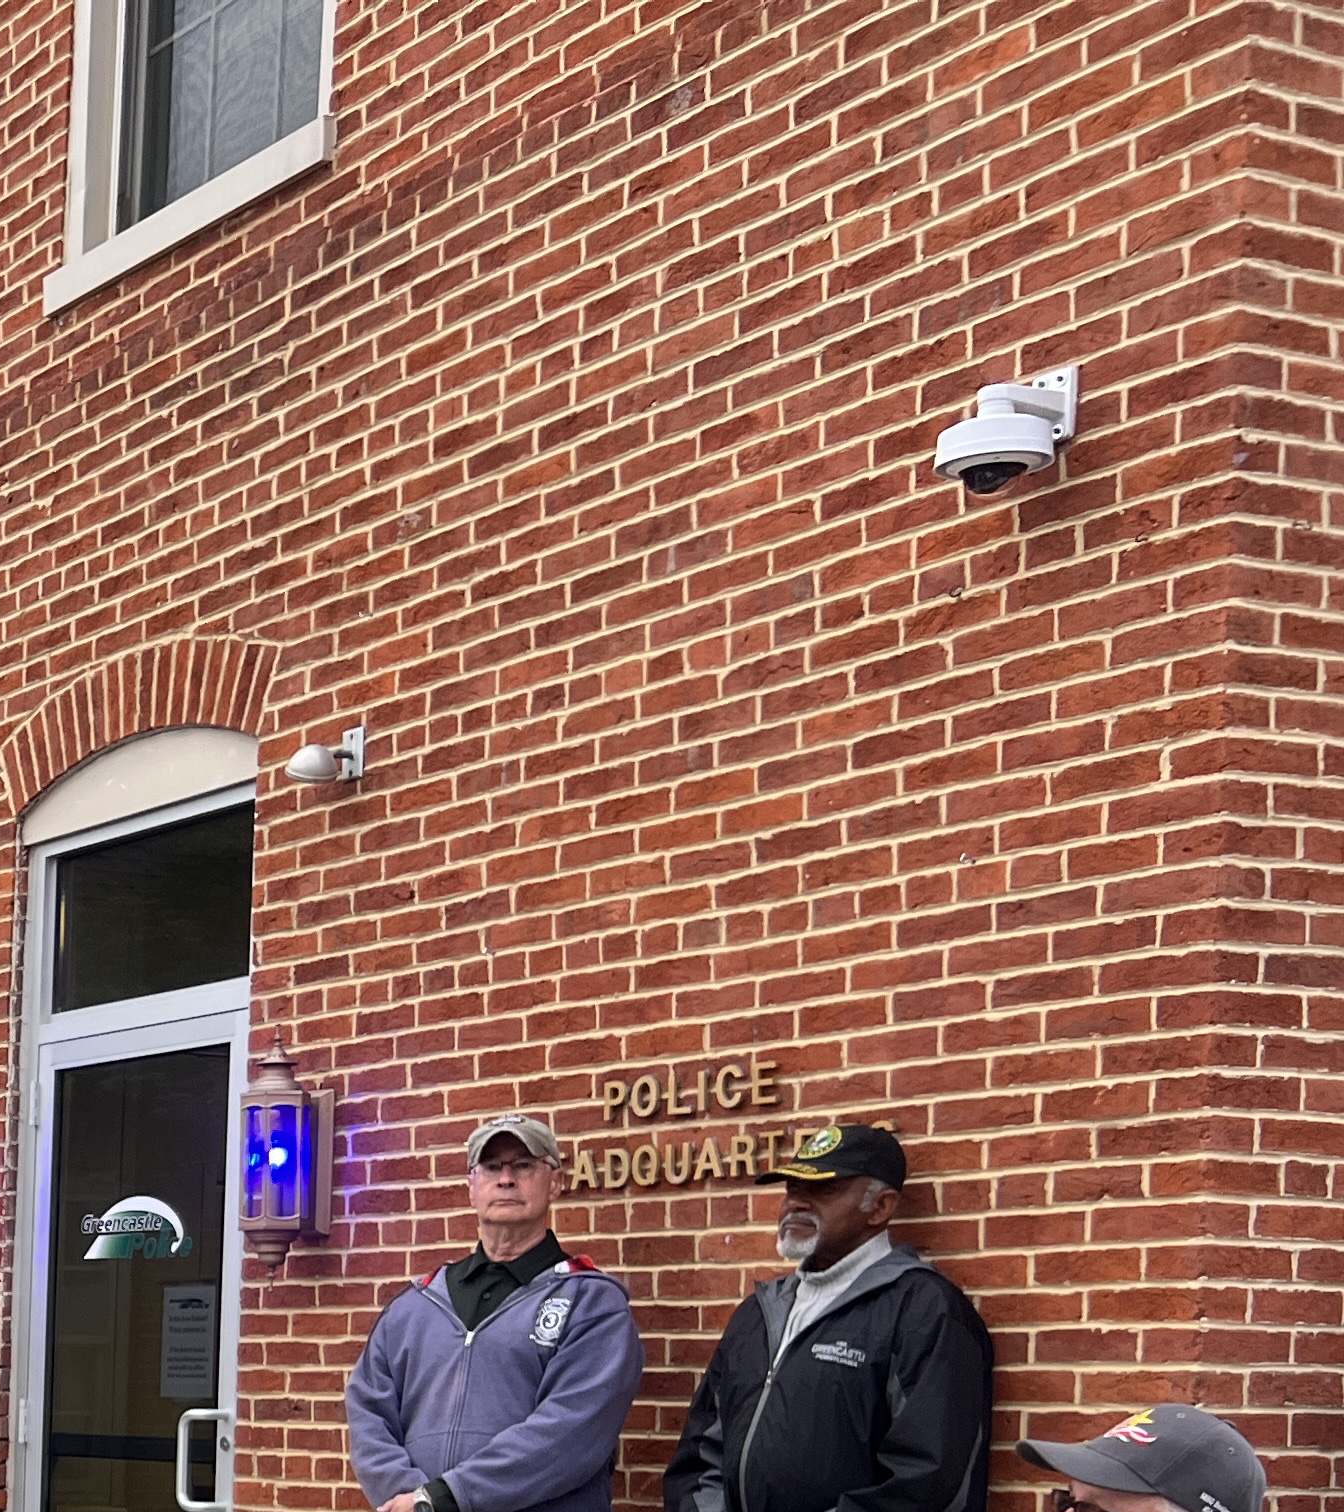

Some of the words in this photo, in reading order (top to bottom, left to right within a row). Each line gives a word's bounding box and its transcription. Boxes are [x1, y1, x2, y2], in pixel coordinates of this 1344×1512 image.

[603, 1060, 779, 1121] POLICE
[81, 1212, 162, 1234] Greencastle
[544, 1313, 557, 1329] 3
